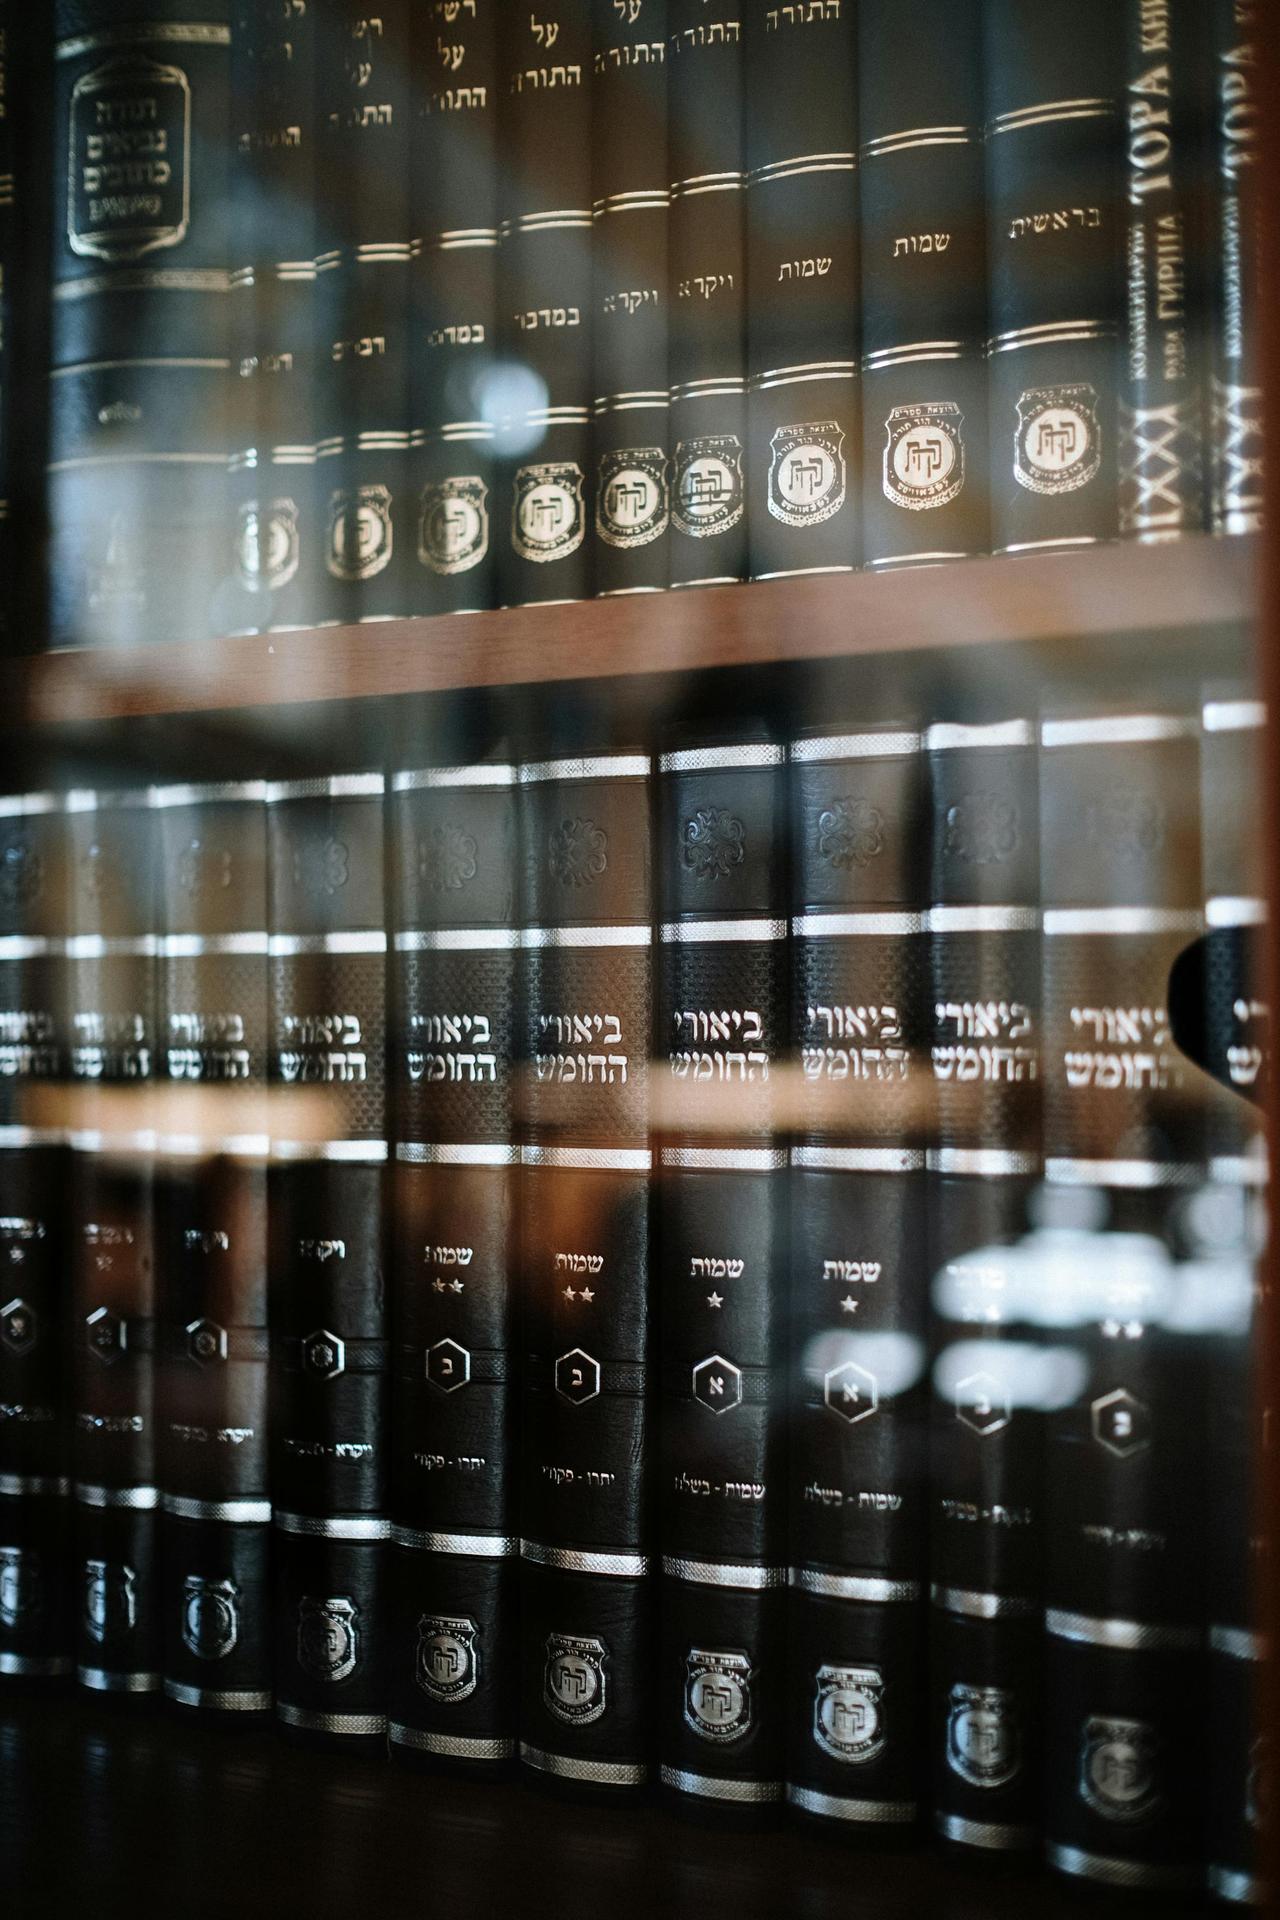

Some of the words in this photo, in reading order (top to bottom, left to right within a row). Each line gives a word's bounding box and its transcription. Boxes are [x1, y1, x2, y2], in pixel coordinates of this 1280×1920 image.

[530, 13, 559, 48] על
[1129, 65, 1172, 205] ТОРА
[893, 232, 951, 258] שמות
[778, 256, 832, 282] שמות
[540, 1014, 623, 1045] ביאורי
[673, 1010, 764, 1043] ביאורי
[808, 1005, 902, 1039] ביאורי
[935, 1001, 1031, 1040] ביאורי
[407, 1053, 498, 1083] החומש
[536, 1053, 629, 1084] החומש
[669, 1051, 770, 1084] החומש
[802, 1047, 910, 1082] החומש
[555, 1252, 604, 1274] שמות
[690, 1256, 745, 1279] שמות
[823, 1259, 882, 1283] שמות
[709, 1375, 725, 1396] א
[842, 1382, 859, 1403] א
